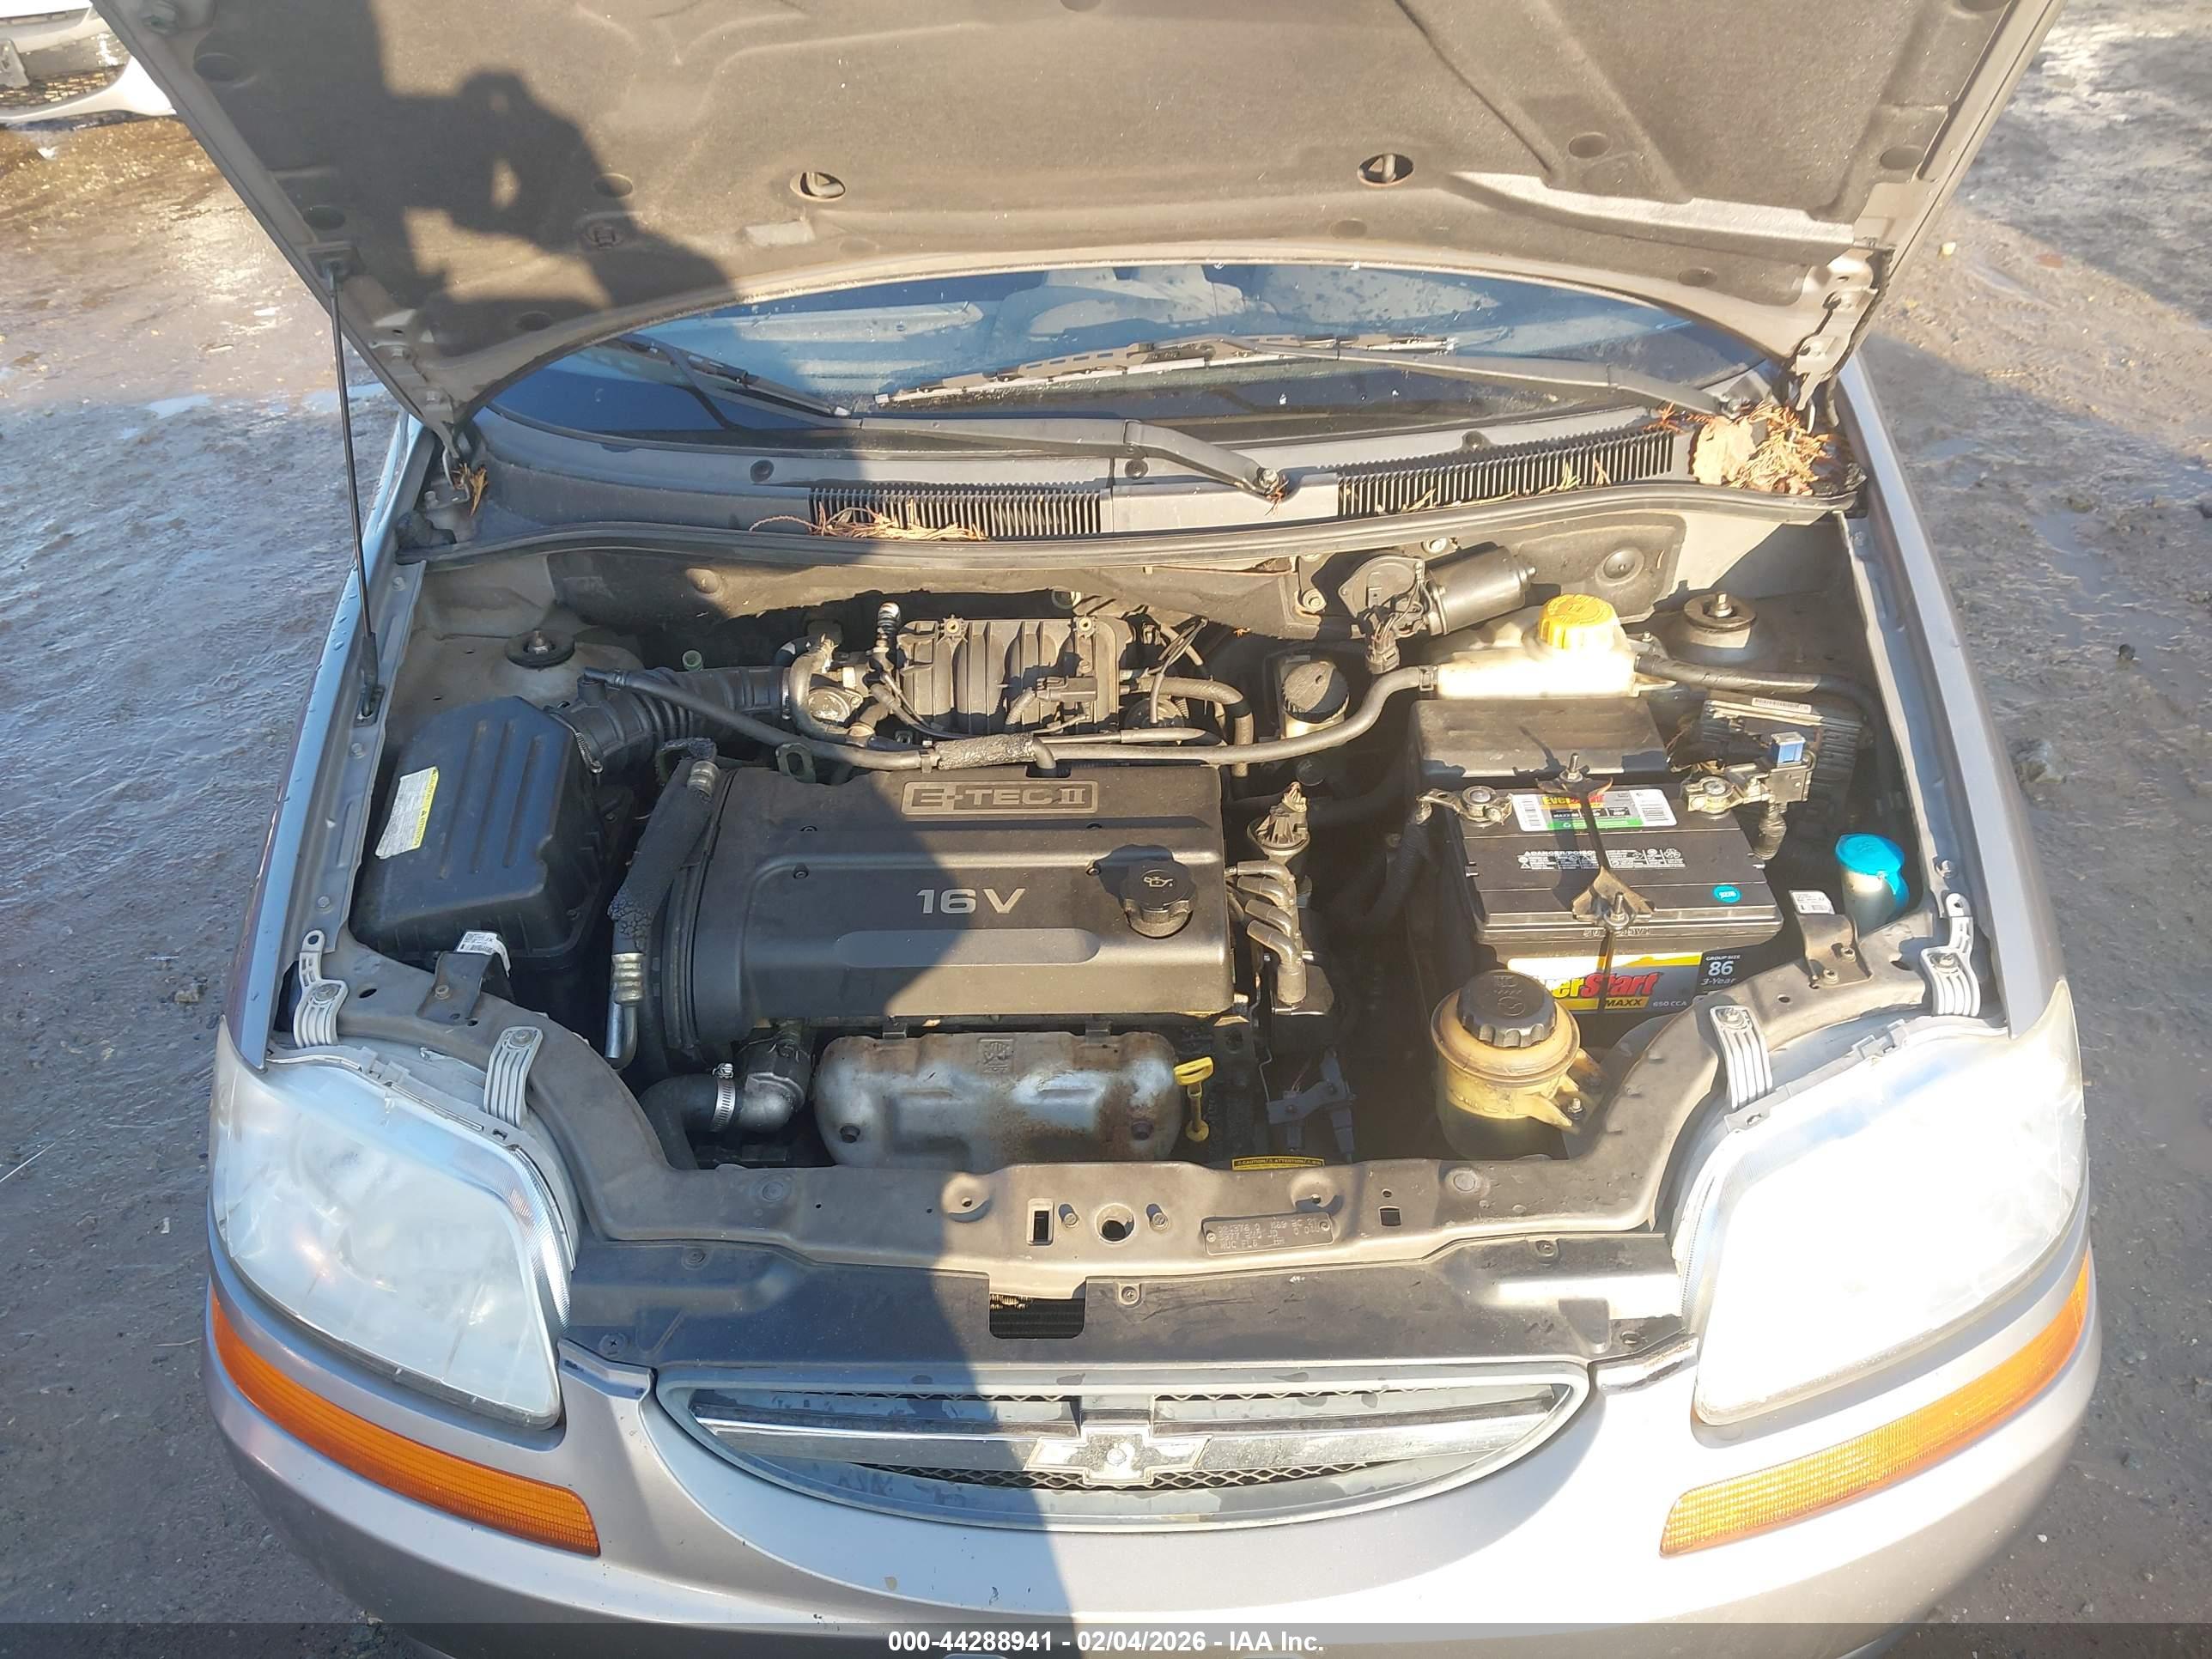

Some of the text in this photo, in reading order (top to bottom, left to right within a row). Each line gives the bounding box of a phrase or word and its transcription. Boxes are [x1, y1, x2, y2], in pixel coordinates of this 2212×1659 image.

[912, 787, 1086, 807] E-TEC II
[917, 888, 1026, 915] 16V
[1707, 961, 1734, 976] 86
